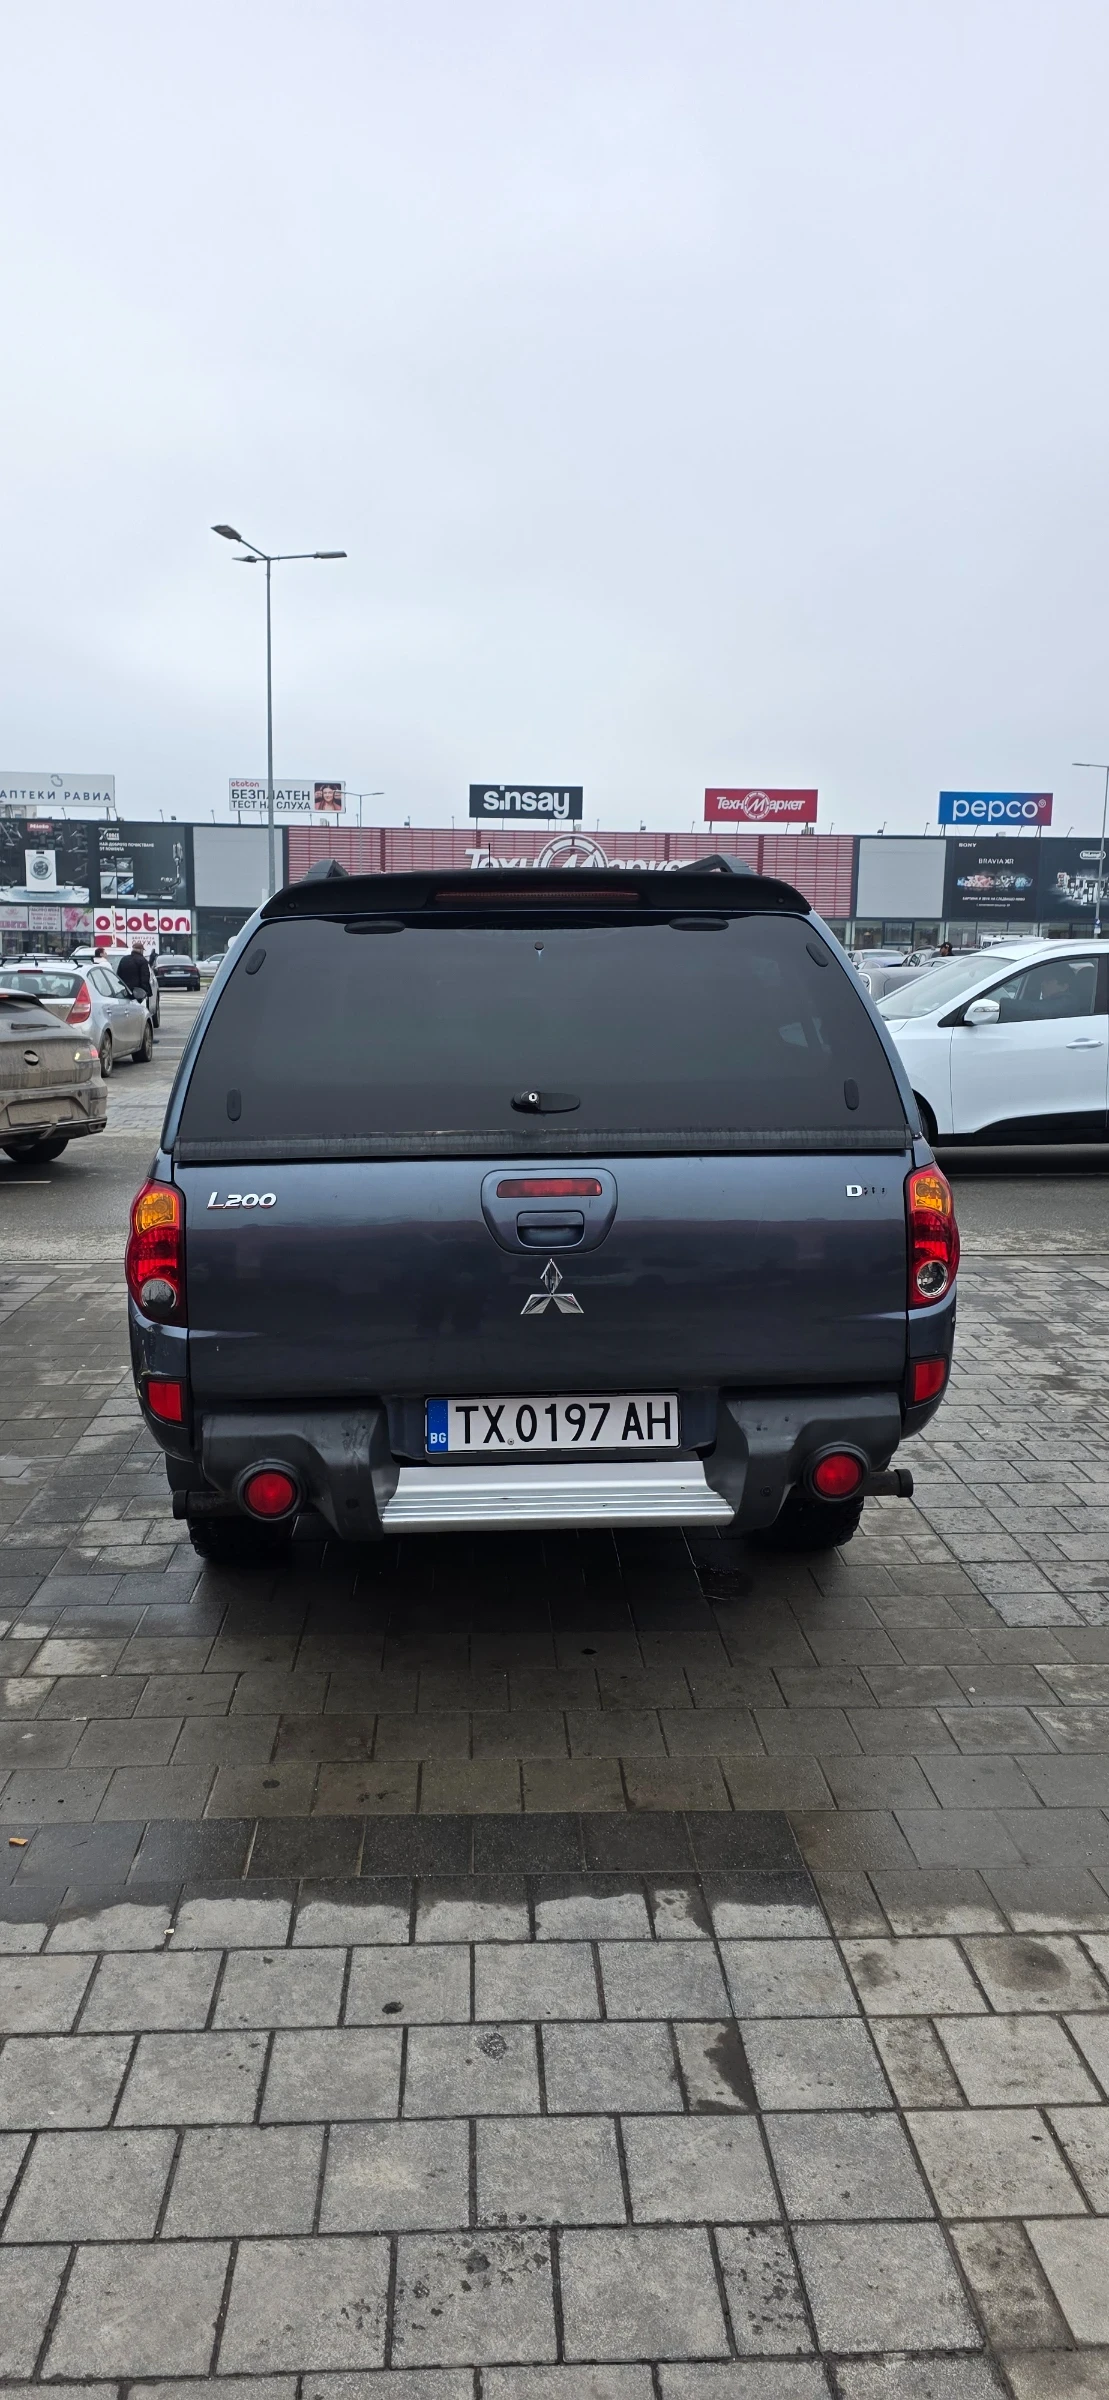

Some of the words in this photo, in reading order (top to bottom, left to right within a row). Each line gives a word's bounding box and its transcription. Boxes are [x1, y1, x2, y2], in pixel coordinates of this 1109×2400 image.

[231, 780, 260, 788] ototon
[0, 790, 56, 800] АПТЕКИ
[64, 791, 112, 801] РАВИА
[483, 785, 570, 819] sinsay
[231, 800, 258, 809] ТЕСТ
[276, 801, 312, 810] СЛУХА
[95, 912, 191, 932] ototon
[206, 1191, 277, 1209] L200
[455, 1404, 506, 1445] TX
[515, 1402, 610, 1443] 0197
[621, 1401, 671, 1441] AH
[430, 1431, 447, 1444] BG
